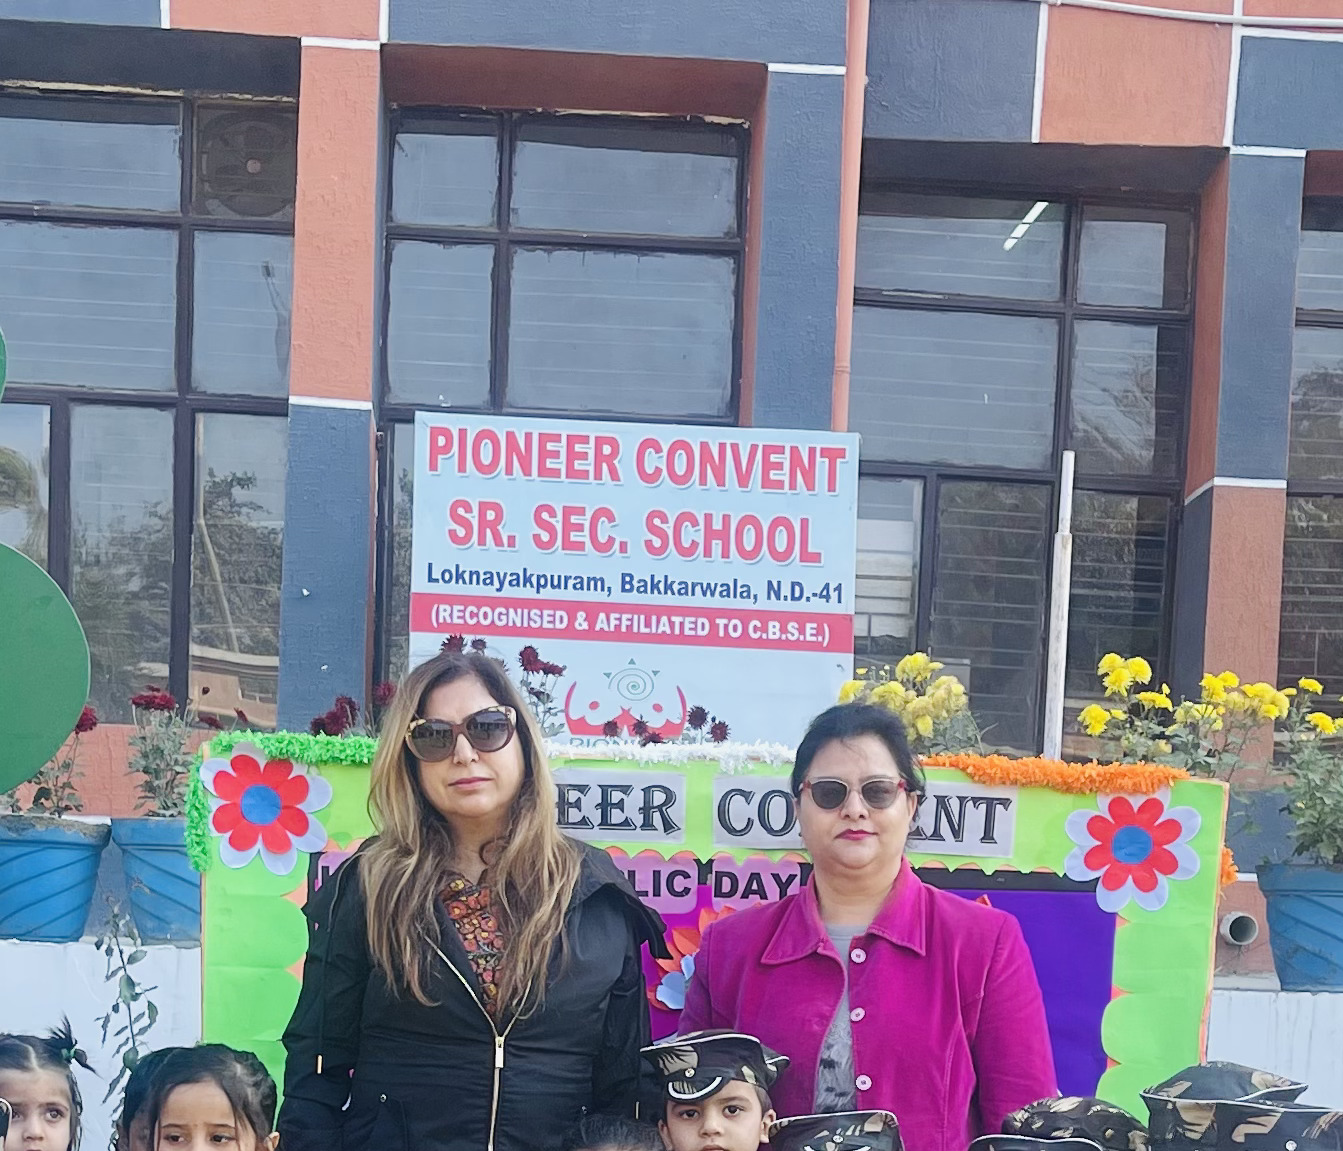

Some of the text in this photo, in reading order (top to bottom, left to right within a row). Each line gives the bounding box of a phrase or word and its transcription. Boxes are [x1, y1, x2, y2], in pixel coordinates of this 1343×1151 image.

[427, 425, 847, 493] PIONEER CONVENT
[447, 498, 822, 564] SR. SEC. SCHOOL
[427, 562, 844, 605] Loknayakpuram, Bakkarwala, N.D.-41
[431, 603, 831, 648] (RECOGNISED & AFFILIATED TO C.B.S.E.)
[713, 869, 799, 901] DAY
